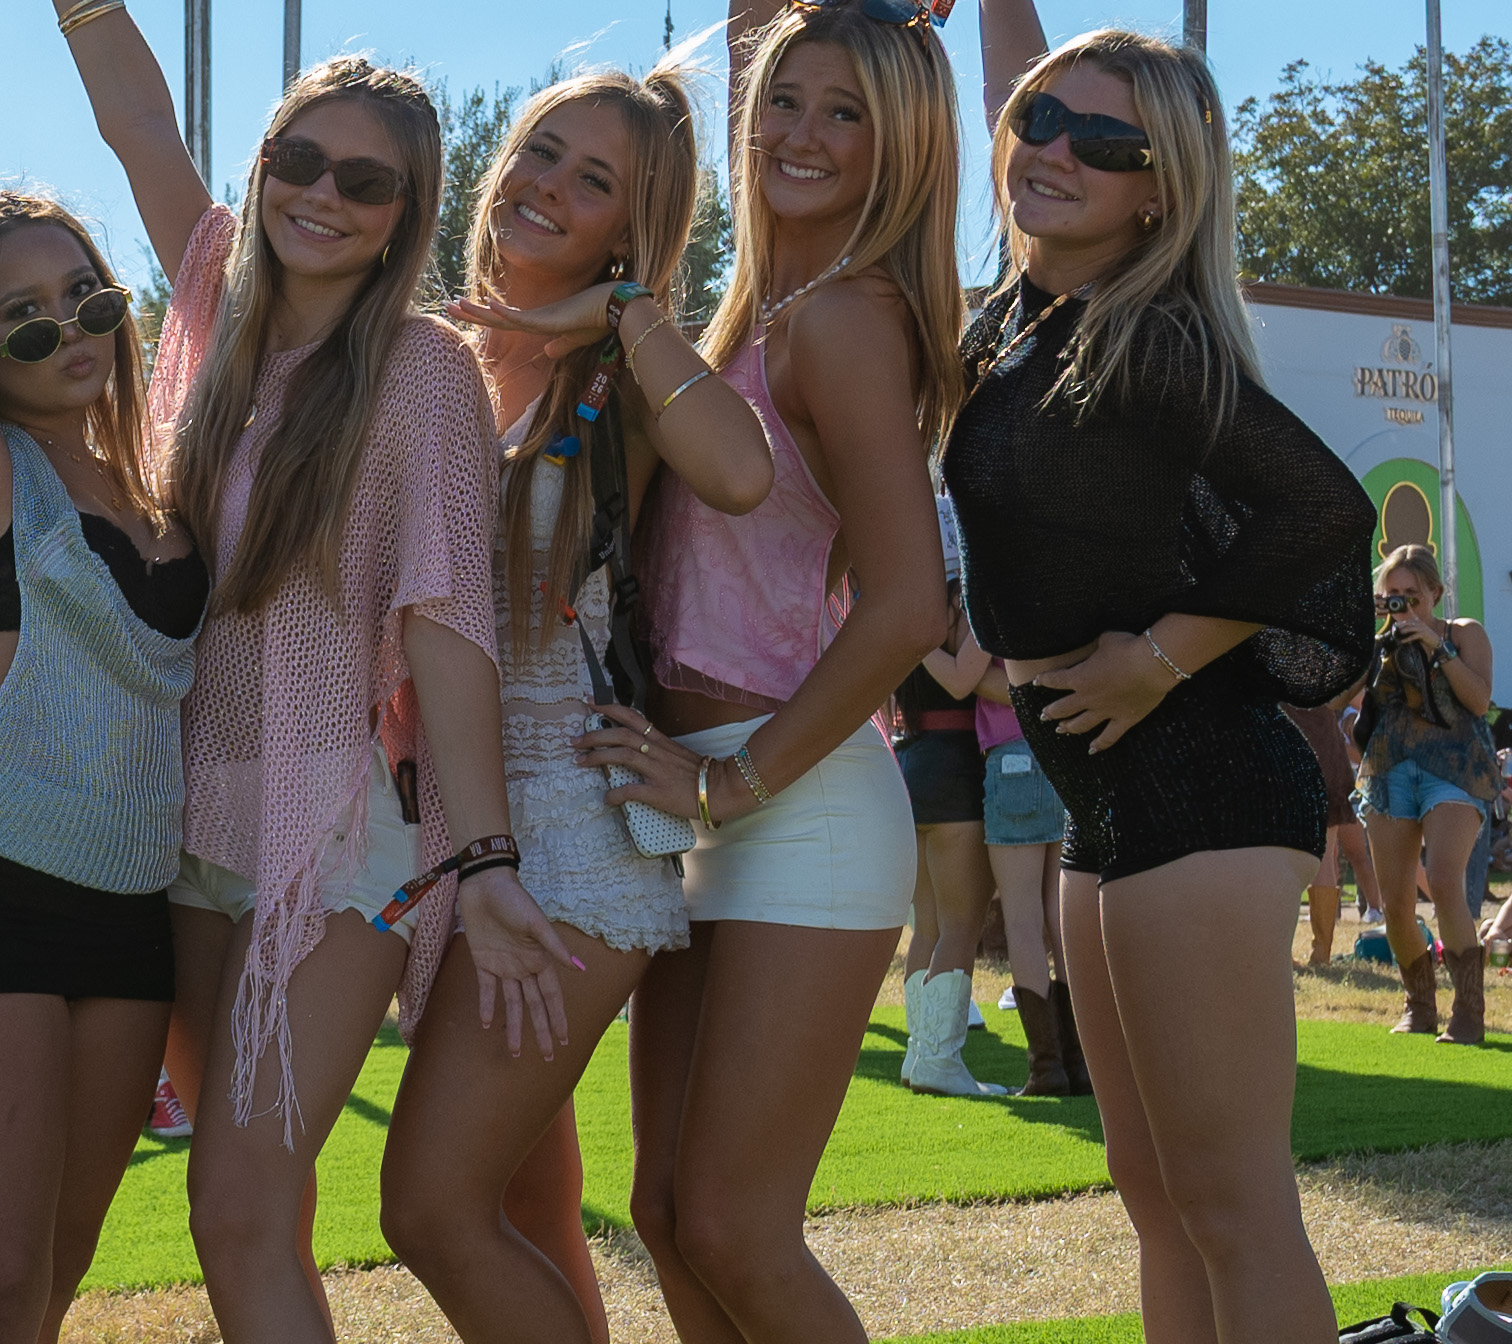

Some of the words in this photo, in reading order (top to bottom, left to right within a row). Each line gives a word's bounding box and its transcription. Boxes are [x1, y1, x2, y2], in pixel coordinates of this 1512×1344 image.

[596, 372, 608, 384] 20
[1356, 362, 1437, 402] PATRÓ
[591, 382, 604, 394] 26
